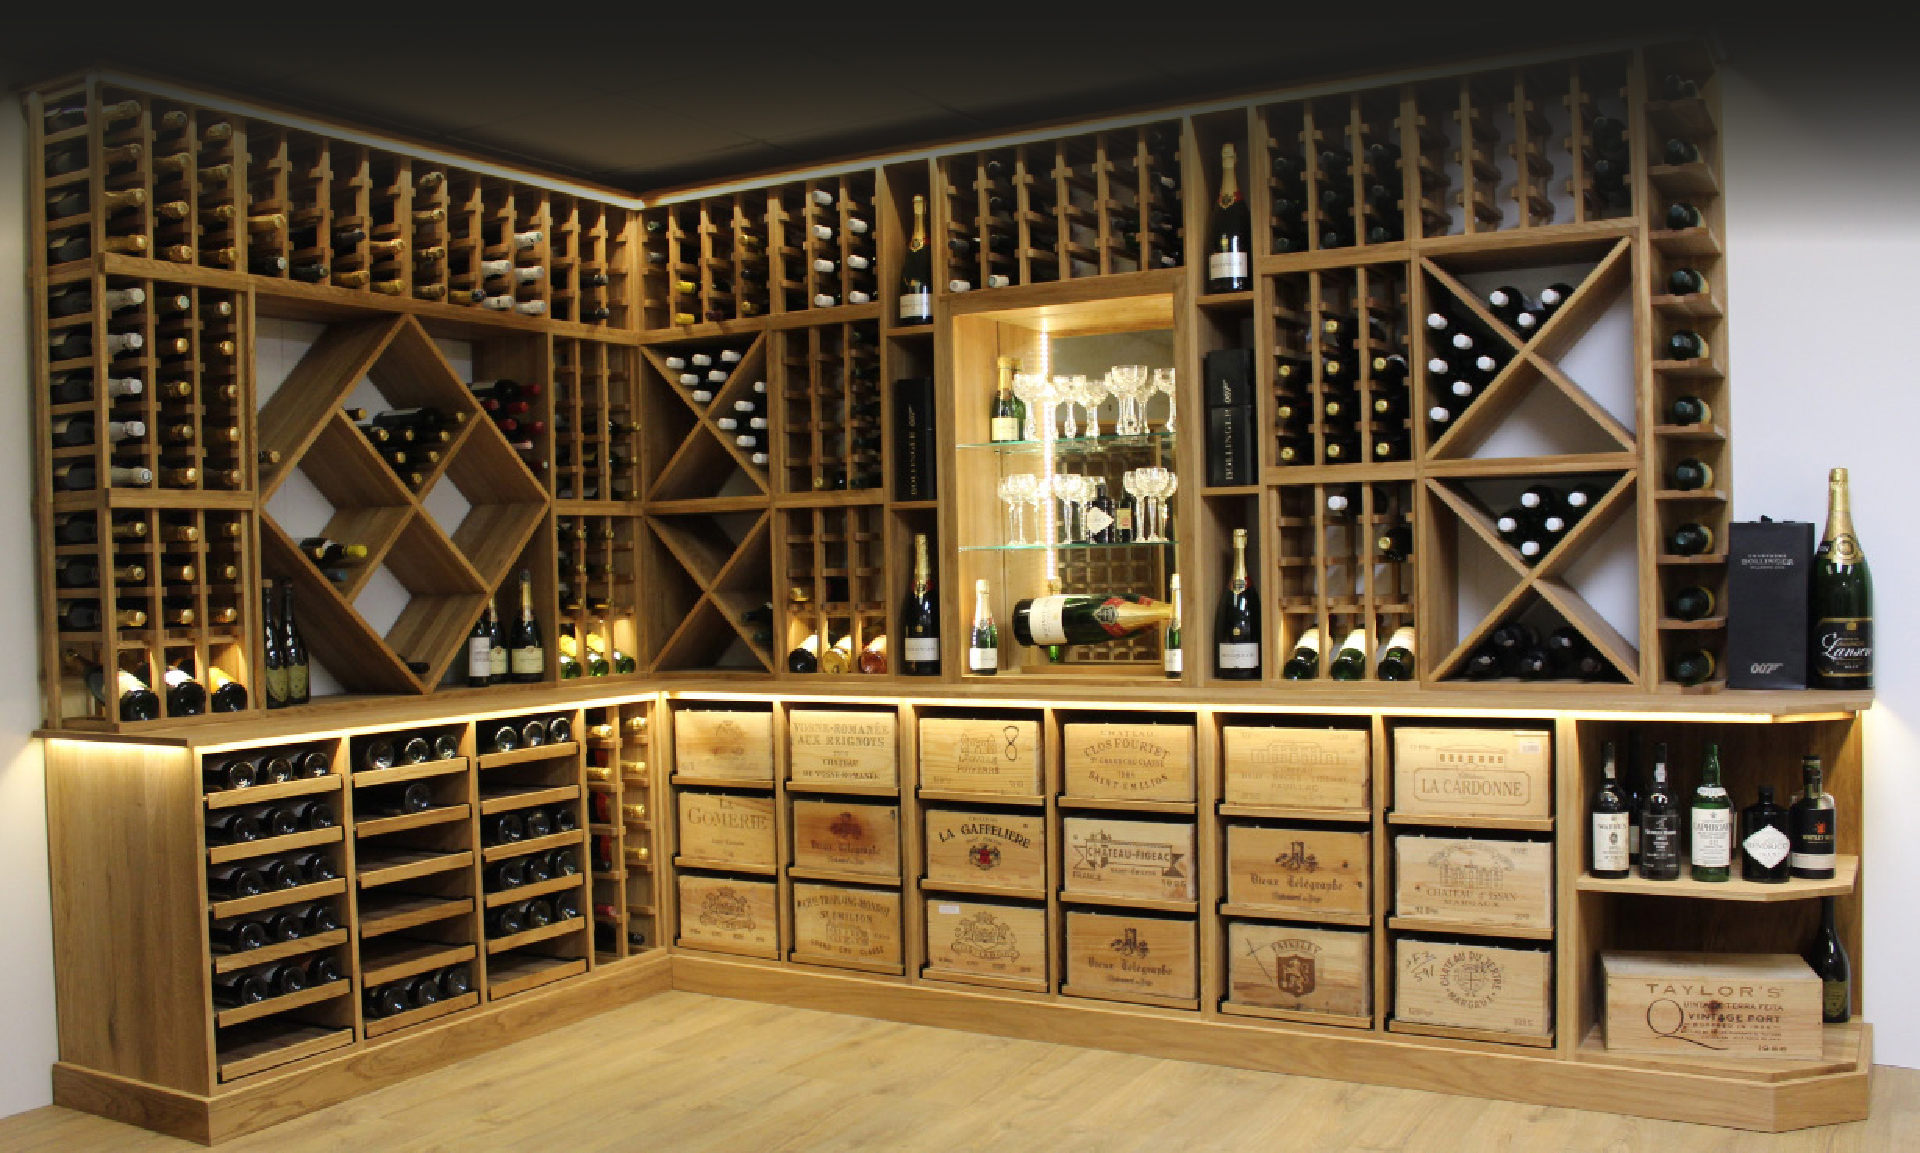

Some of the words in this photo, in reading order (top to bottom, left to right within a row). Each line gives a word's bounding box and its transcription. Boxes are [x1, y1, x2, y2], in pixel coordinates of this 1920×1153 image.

[1750, 662, 1784, 674] 007
[1421, 778, 1440, 793] LA
[1442, 779, 1523, 797] CARDONNE
[939, 828, 956, 843] LA
[1645, 983, 1785, 999] TAYLOR'S
[1688, 1012, 1744, 1023] VINTAGE
[1747, 1014, 1781, 1023] PORT
